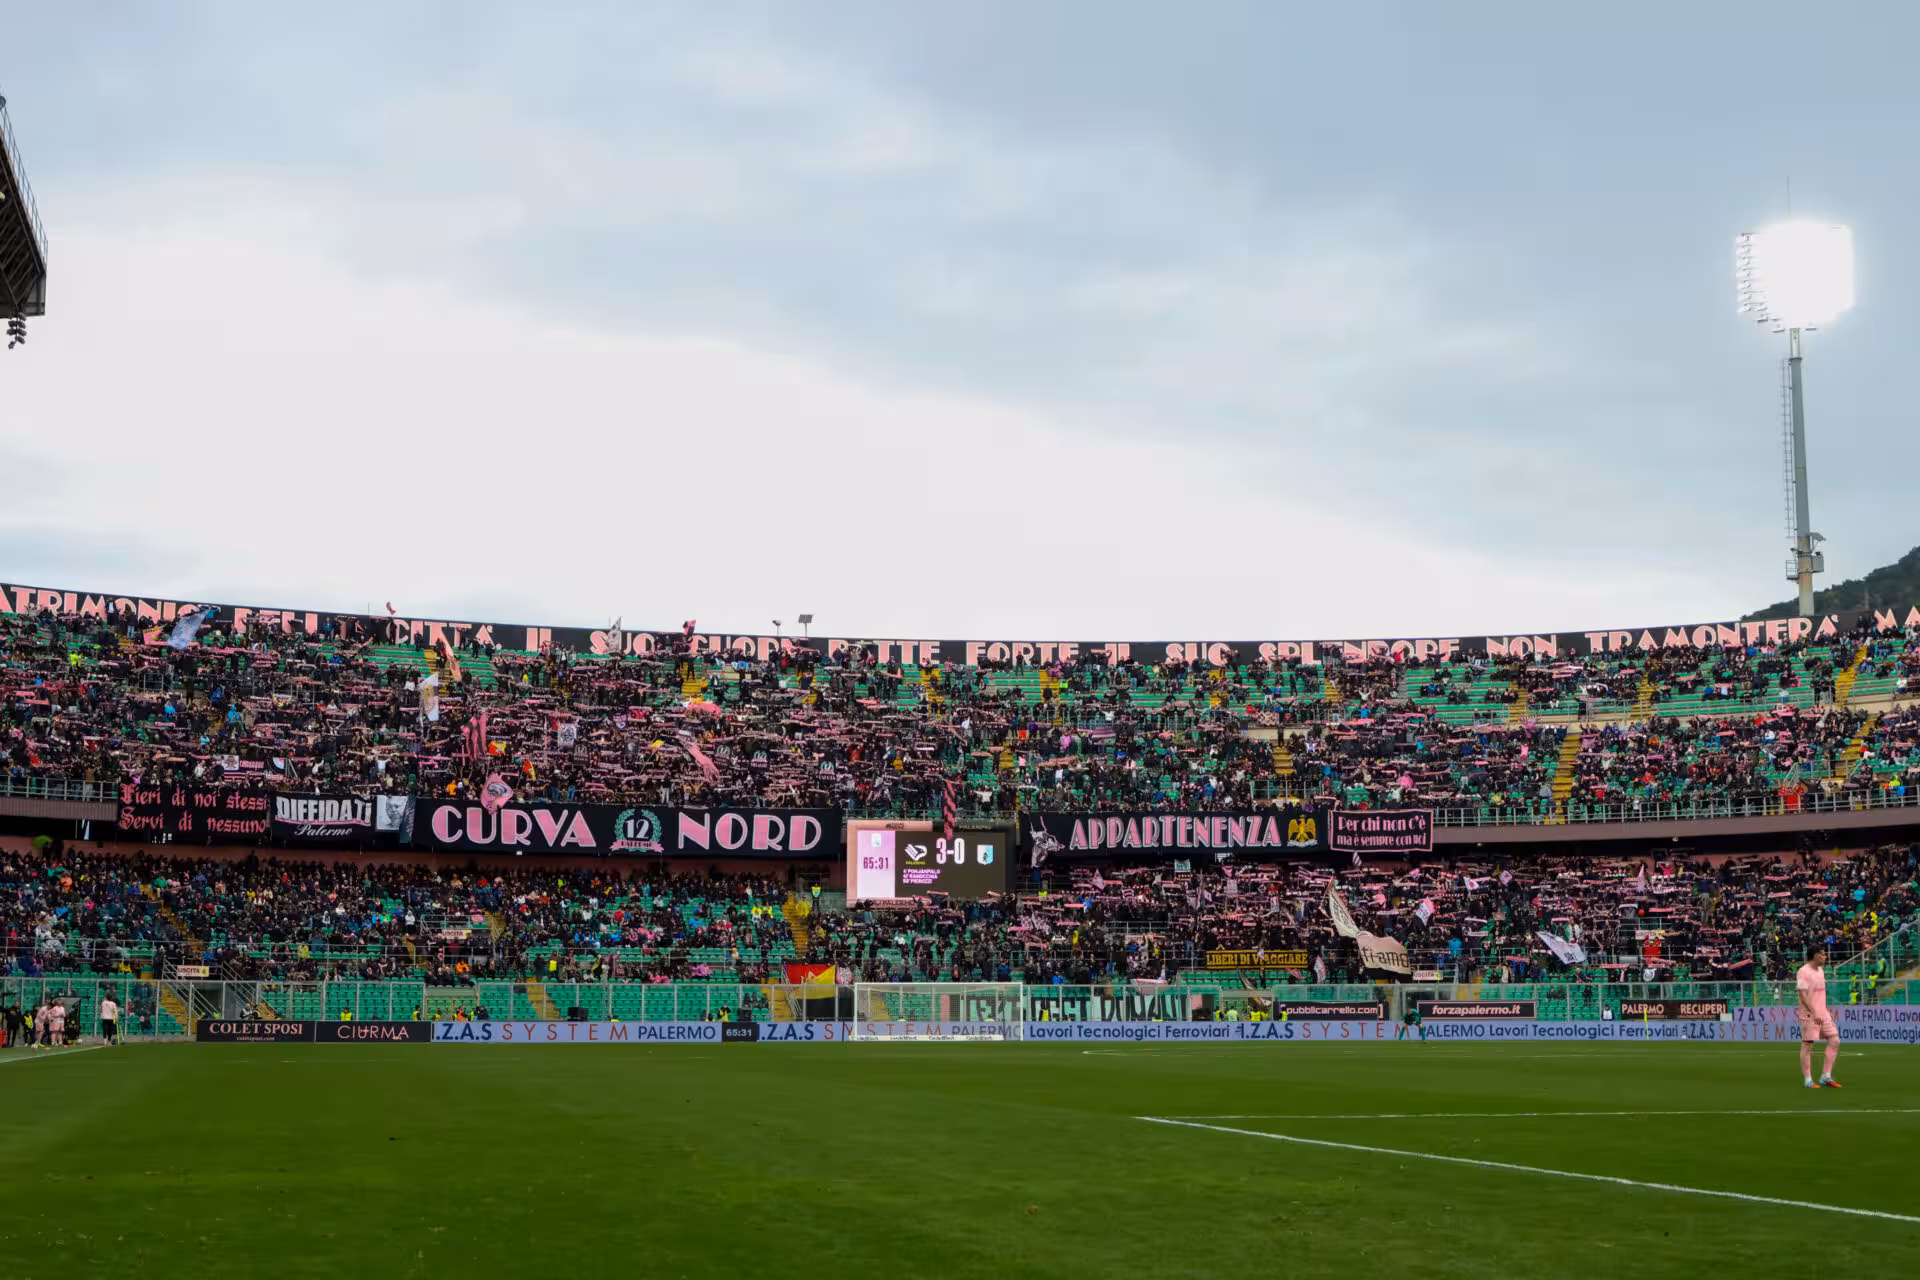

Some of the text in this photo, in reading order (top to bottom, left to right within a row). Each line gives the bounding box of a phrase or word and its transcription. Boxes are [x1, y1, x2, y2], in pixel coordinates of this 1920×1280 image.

[829, 640, 940, 664] BTTE
[1258, 639, 1460, 666] SPLNDORE
[1486, 634, 1557, 658] NON
[172, 787, 186, 807] di
[178, 811, 193, 831] di
[207, 817, 267, 833] nessuno
[432, 806, 822, 851] CURVA 12 NORD
[1338, 816, 1358, 831] Per
[1362, 816, 1380, 832] chi
[1383, 817, 1406, 831] non
[294, 824, 353, 836] Palermo
[1070, 815, 1281, 850] APPARTENENZA
[1337, 834, 1352, 845] ma
[1360, 834, 1394, 846] sempre
[1396, 835, 1412, 846] con
[863, 857, 889, 869] 65:31
[1207, 953, 1238, 965] LIBERI
[1240, 953, 1251, 965] DI
[1432, 1004, 1521, 1016] forzapalermo.it
[1622, 1003, 1726, 1014] PALERMO RECUPERI
[209, 1023, 302, 1034] COLET SPOSI
[638, 1026, 715, 1040] PALERMO
[726, 1029, 752, 1037] 65:31
[1030, 1025, 1073, 1038] Lavori
[1077, 1025, 1161, 1040] Tecnologici
[1166, 1025, 1230, 1038] Ferroviari
[1490, 1025, 1528, 1037] Lavori
[1532, 1024, 1614, 1039] Tecnologici
[1620, 1024, 1678, 1037] Ferroviari
